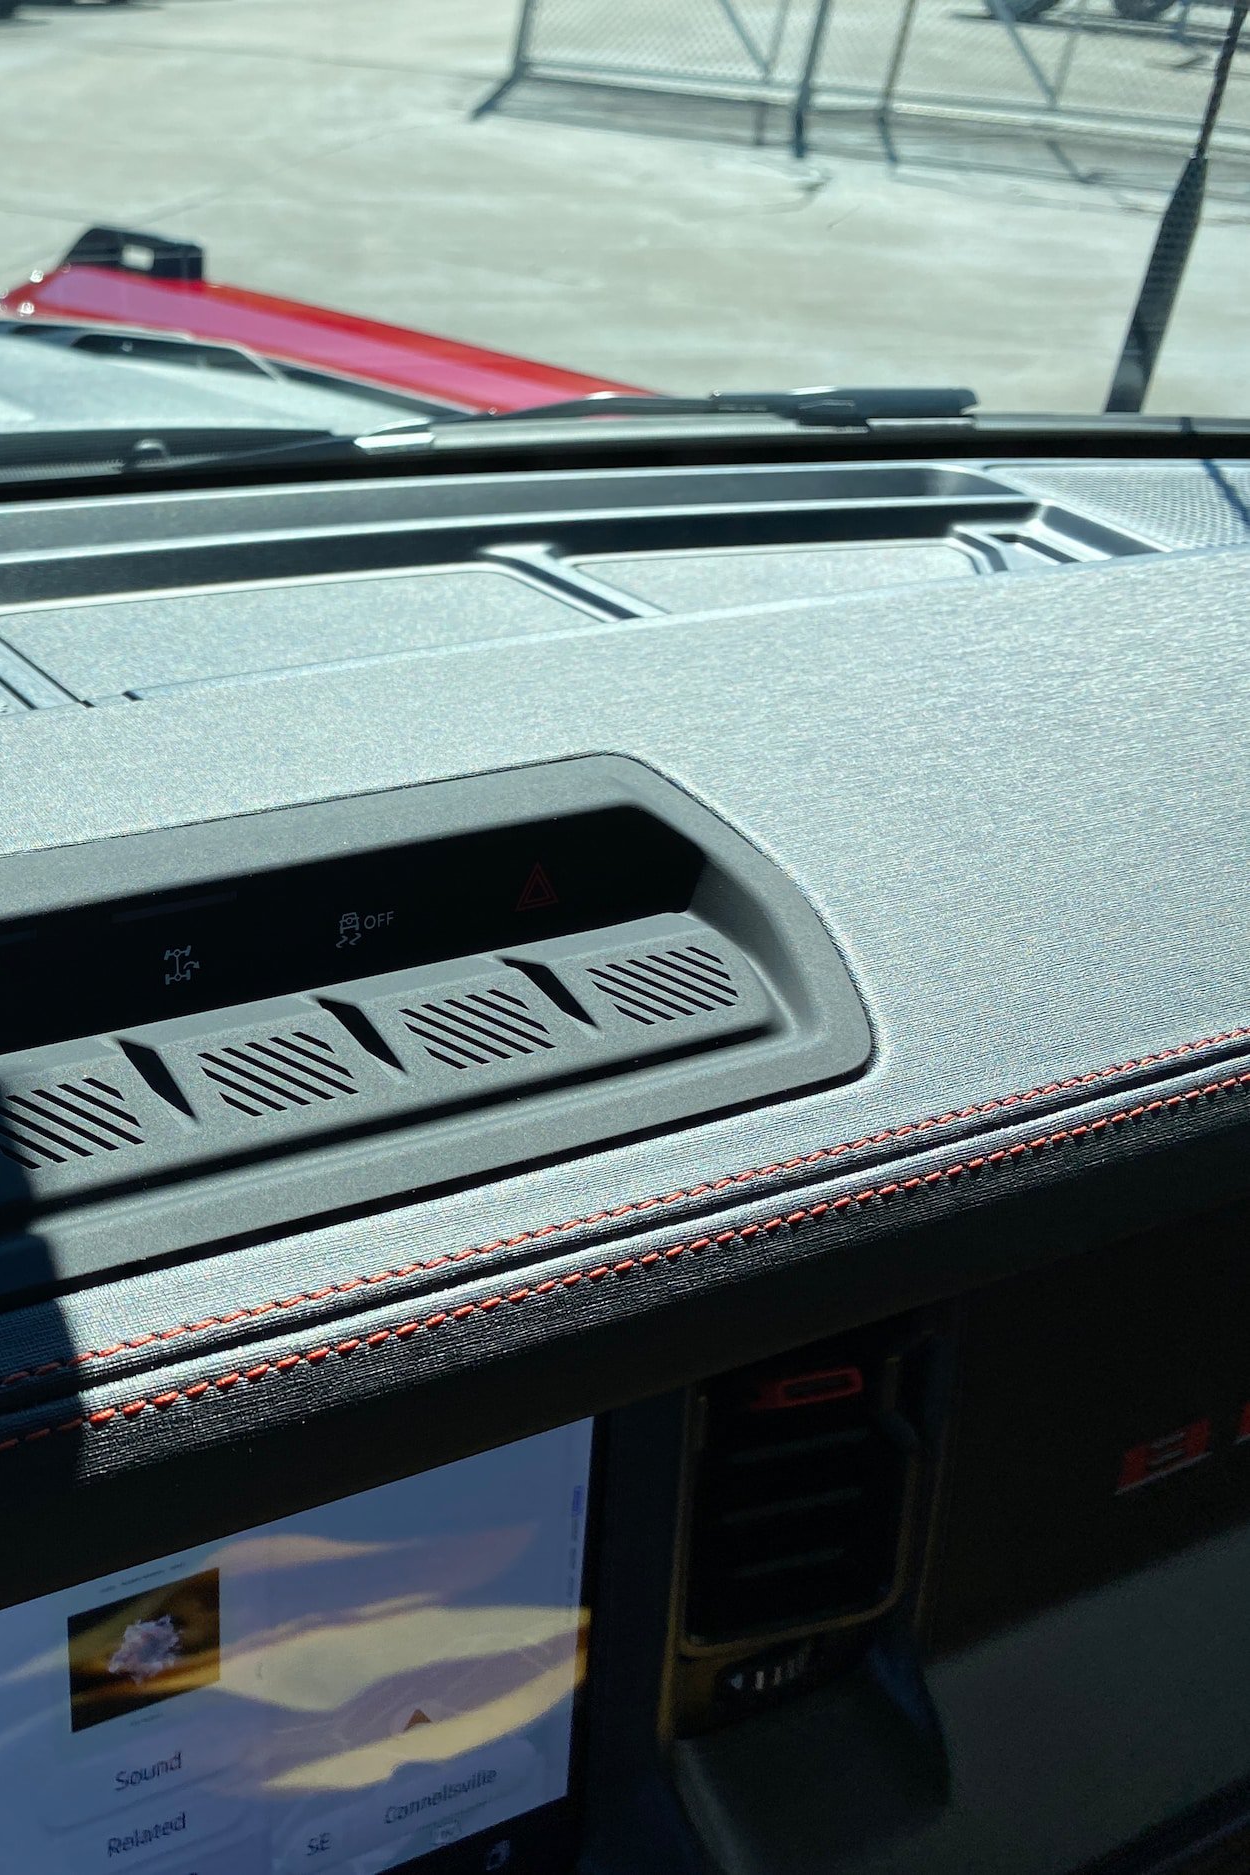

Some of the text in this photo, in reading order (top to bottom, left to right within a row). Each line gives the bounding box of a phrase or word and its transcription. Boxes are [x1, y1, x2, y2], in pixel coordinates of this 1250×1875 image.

[364, 911, 394, 930] OFF
[114, 1751, 183, 1791] Sound
[107, 1812, 186, 1857] Related
[305, 1831, 332, 1857] SE
